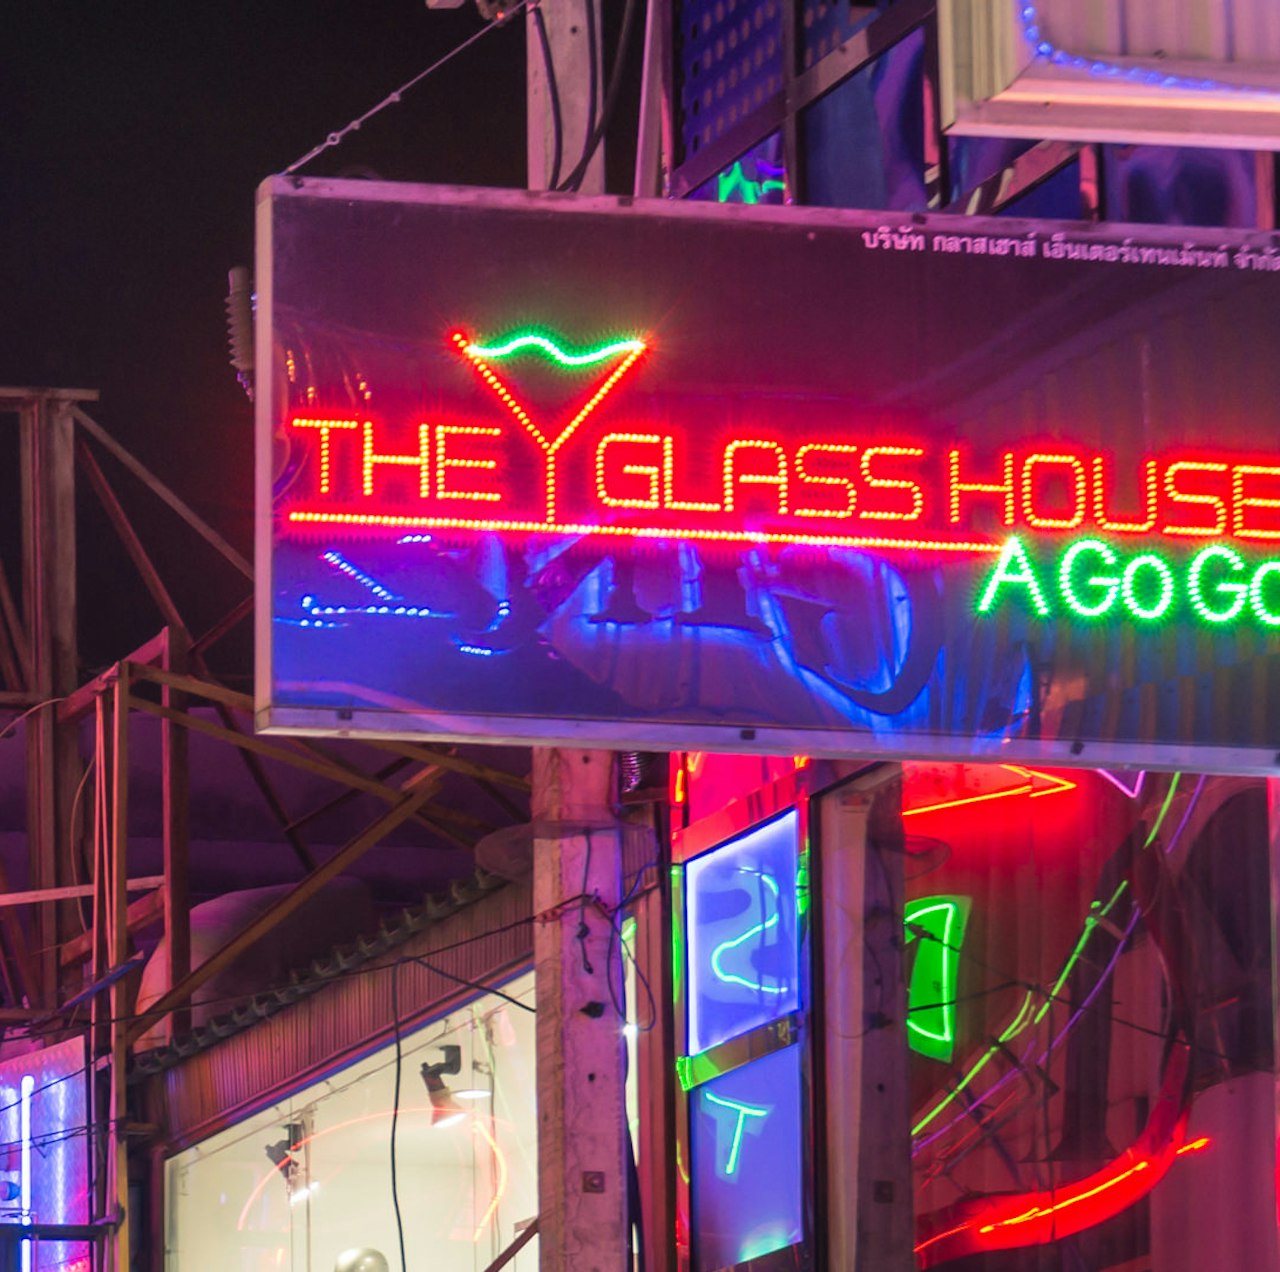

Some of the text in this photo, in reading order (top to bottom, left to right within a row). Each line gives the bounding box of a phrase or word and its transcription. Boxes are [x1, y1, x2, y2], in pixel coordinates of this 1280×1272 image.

[292, 417, 502, 502] THE
[596, 432, 925, 521] GLASS
[975, 533, 1050, 618] A
